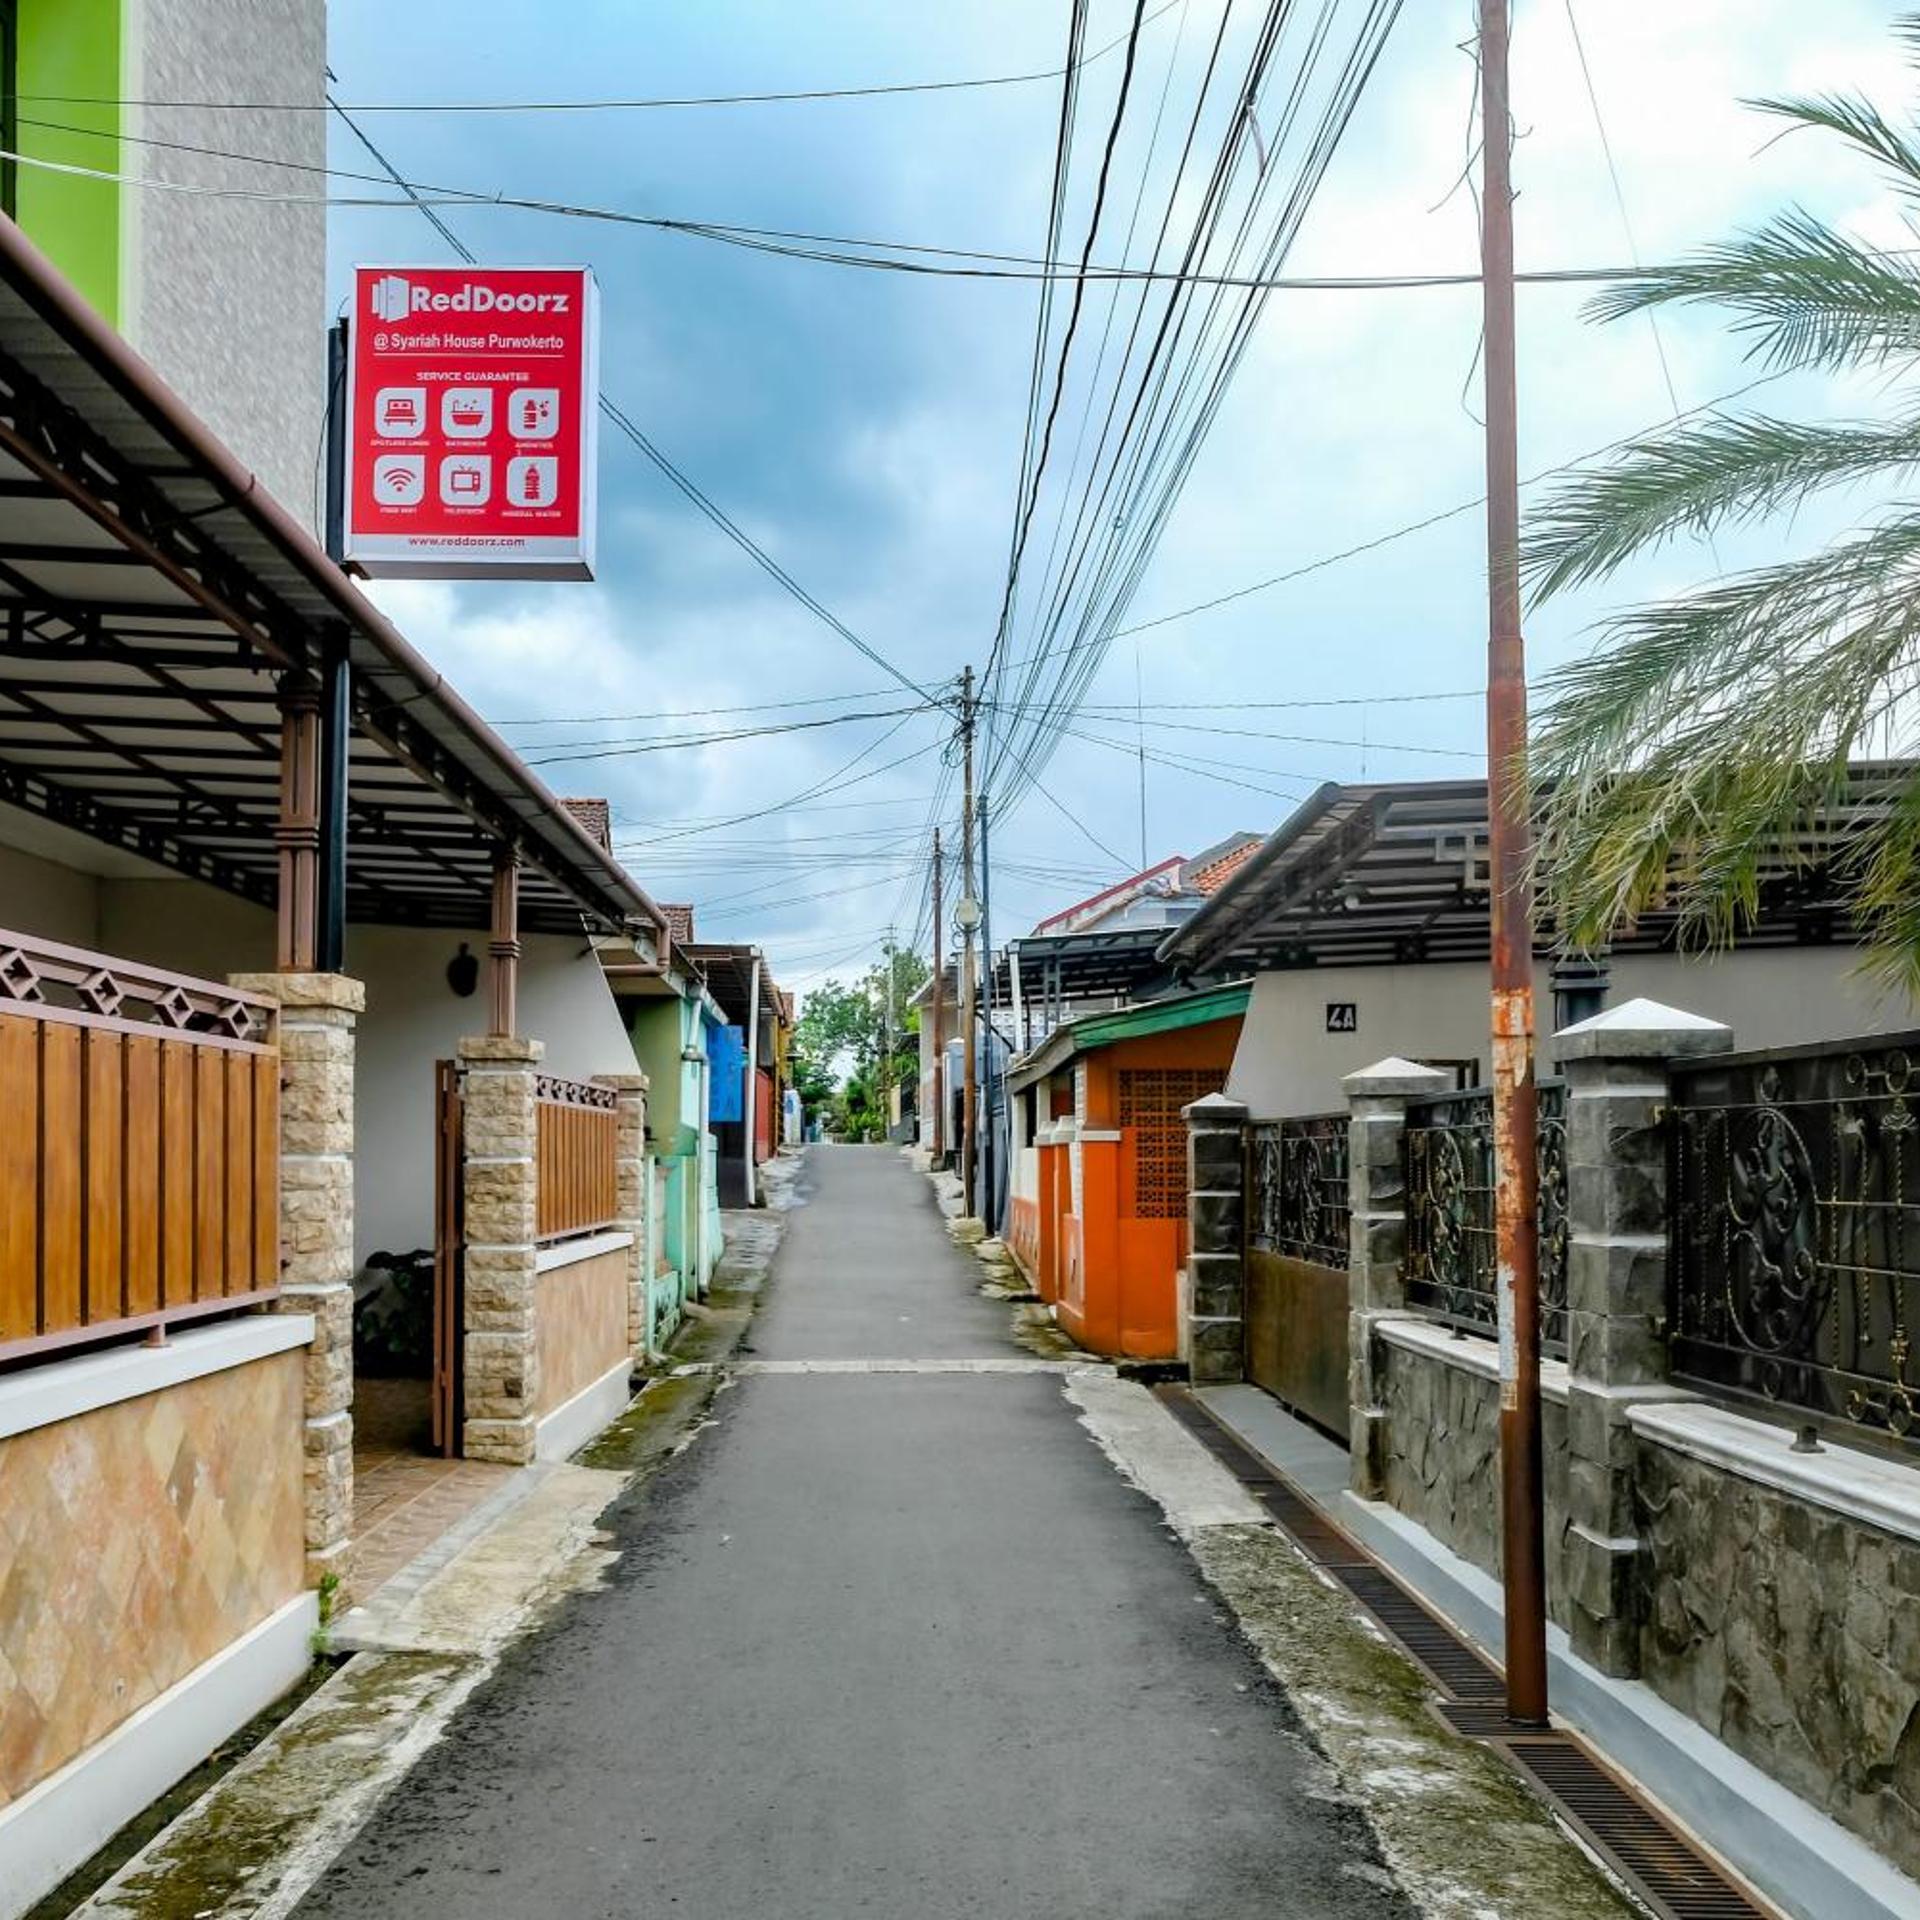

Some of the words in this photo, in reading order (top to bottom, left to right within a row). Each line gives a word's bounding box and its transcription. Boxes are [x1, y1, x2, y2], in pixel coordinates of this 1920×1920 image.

[411, 284, 569, 312] RedDoorz
[374, 333, 389, 351] @
[391, 333, 440, 351] Syariah
[443, 333, 485, 349] House
[488, 333, 564, 349] Purwokerto
[416, 371, 461, 381] SERVICE
[464, 372, 530, 382] GUARANTEE
[408, 537, 525, 547] www.reddoorz.com
[1328, 1007, 1355, 1028] 4A
